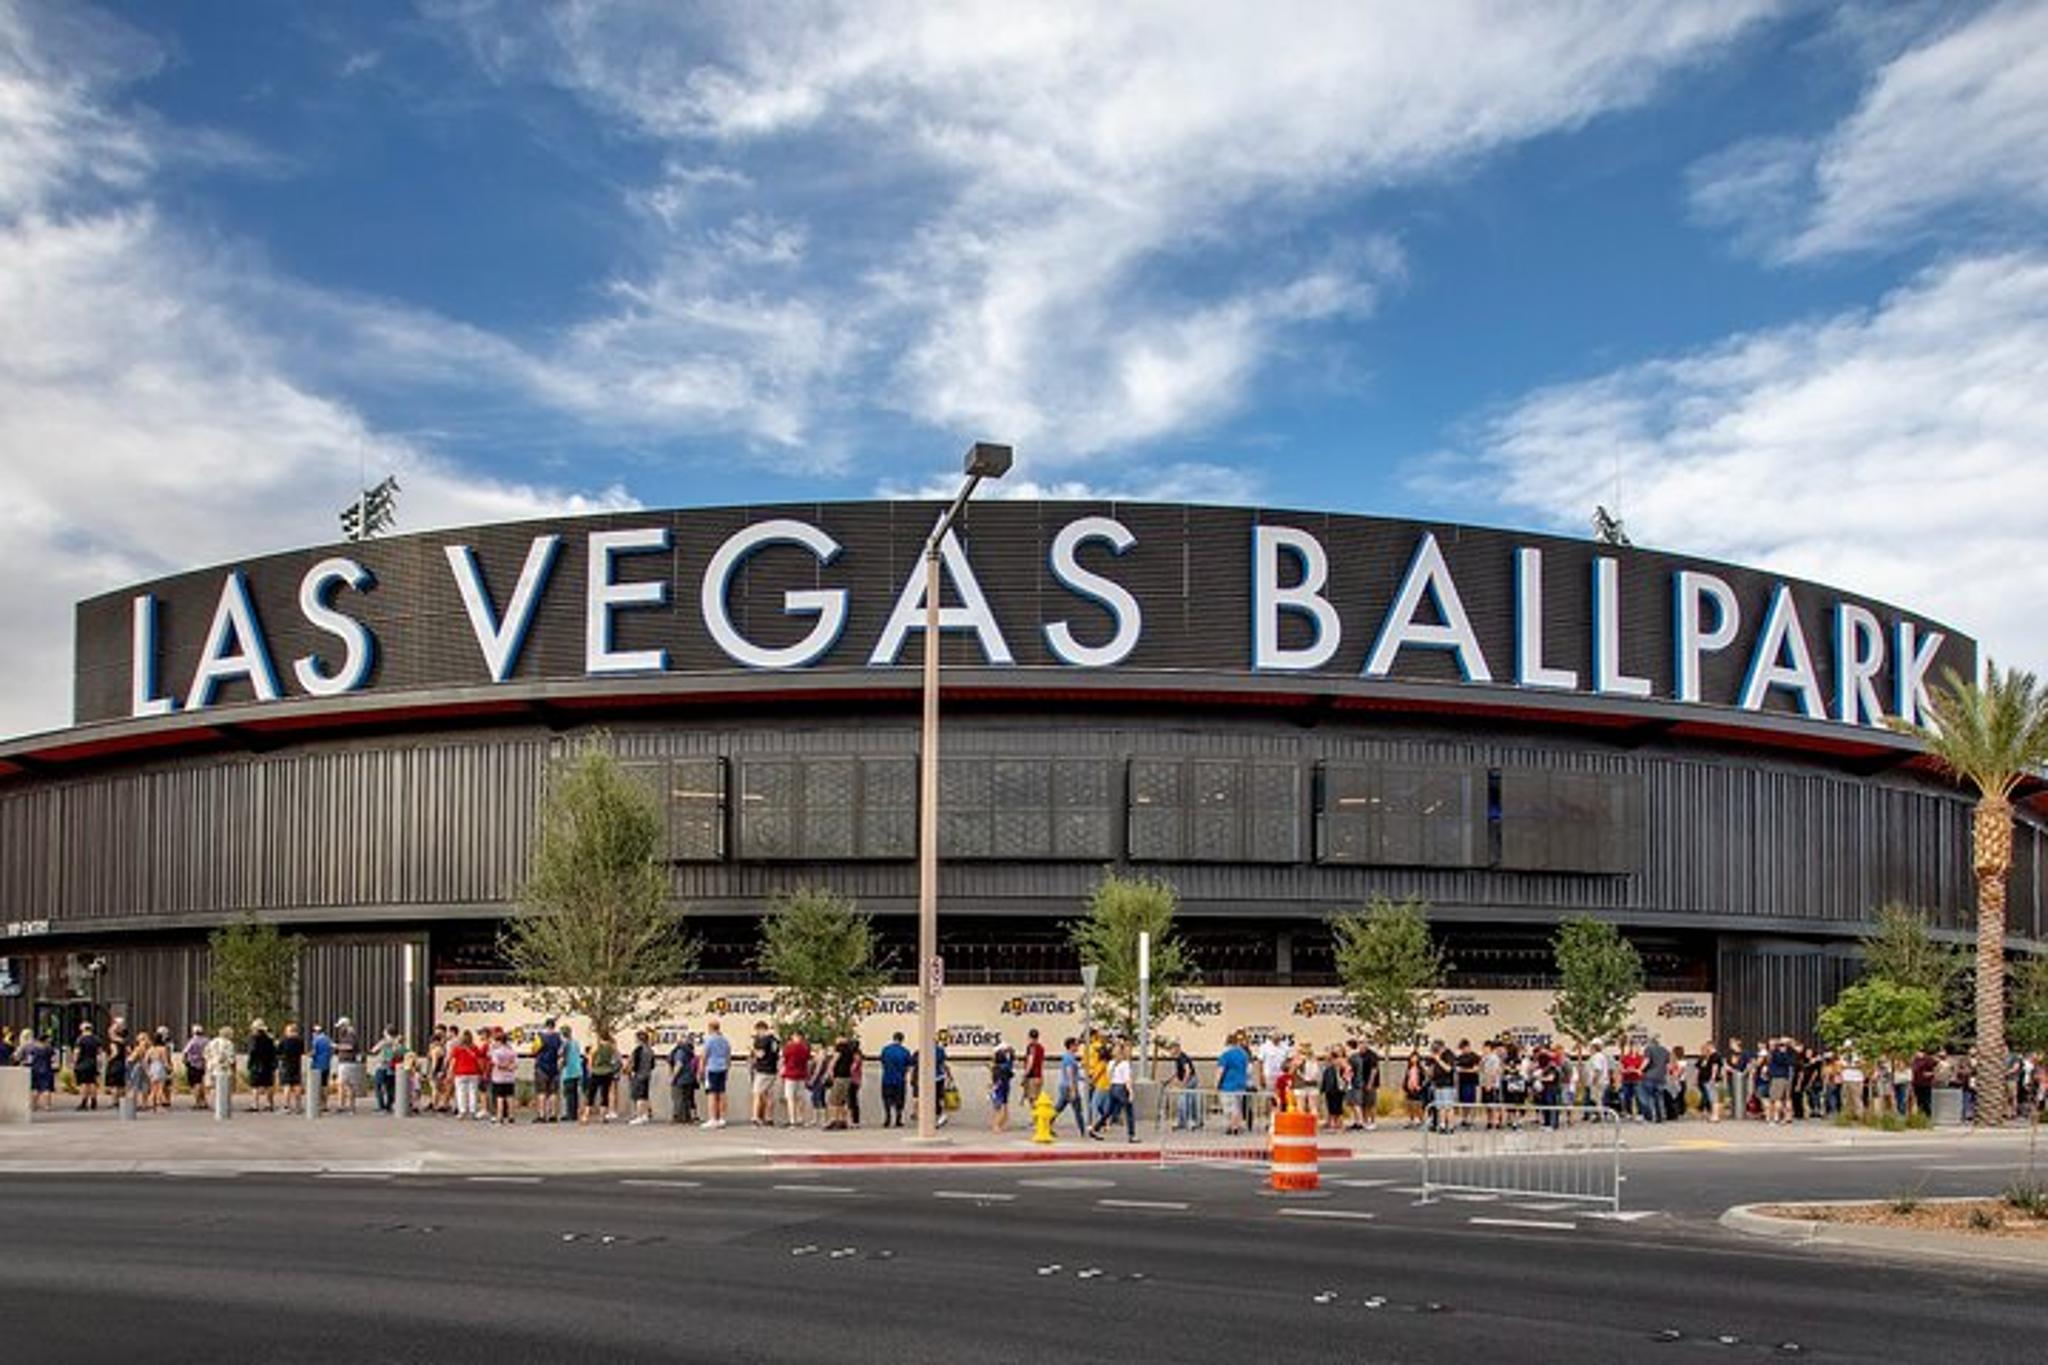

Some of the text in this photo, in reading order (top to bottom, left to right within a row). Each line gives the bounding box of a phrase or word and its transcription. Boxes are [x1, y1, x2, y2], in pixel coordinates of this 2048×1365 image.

[132, 512, 1946, 740] LAS VEGAS BALLPARK
[444, 997, 505, 1014] AIATORS
[1001, 998, 1075, 1016] AIATORS
